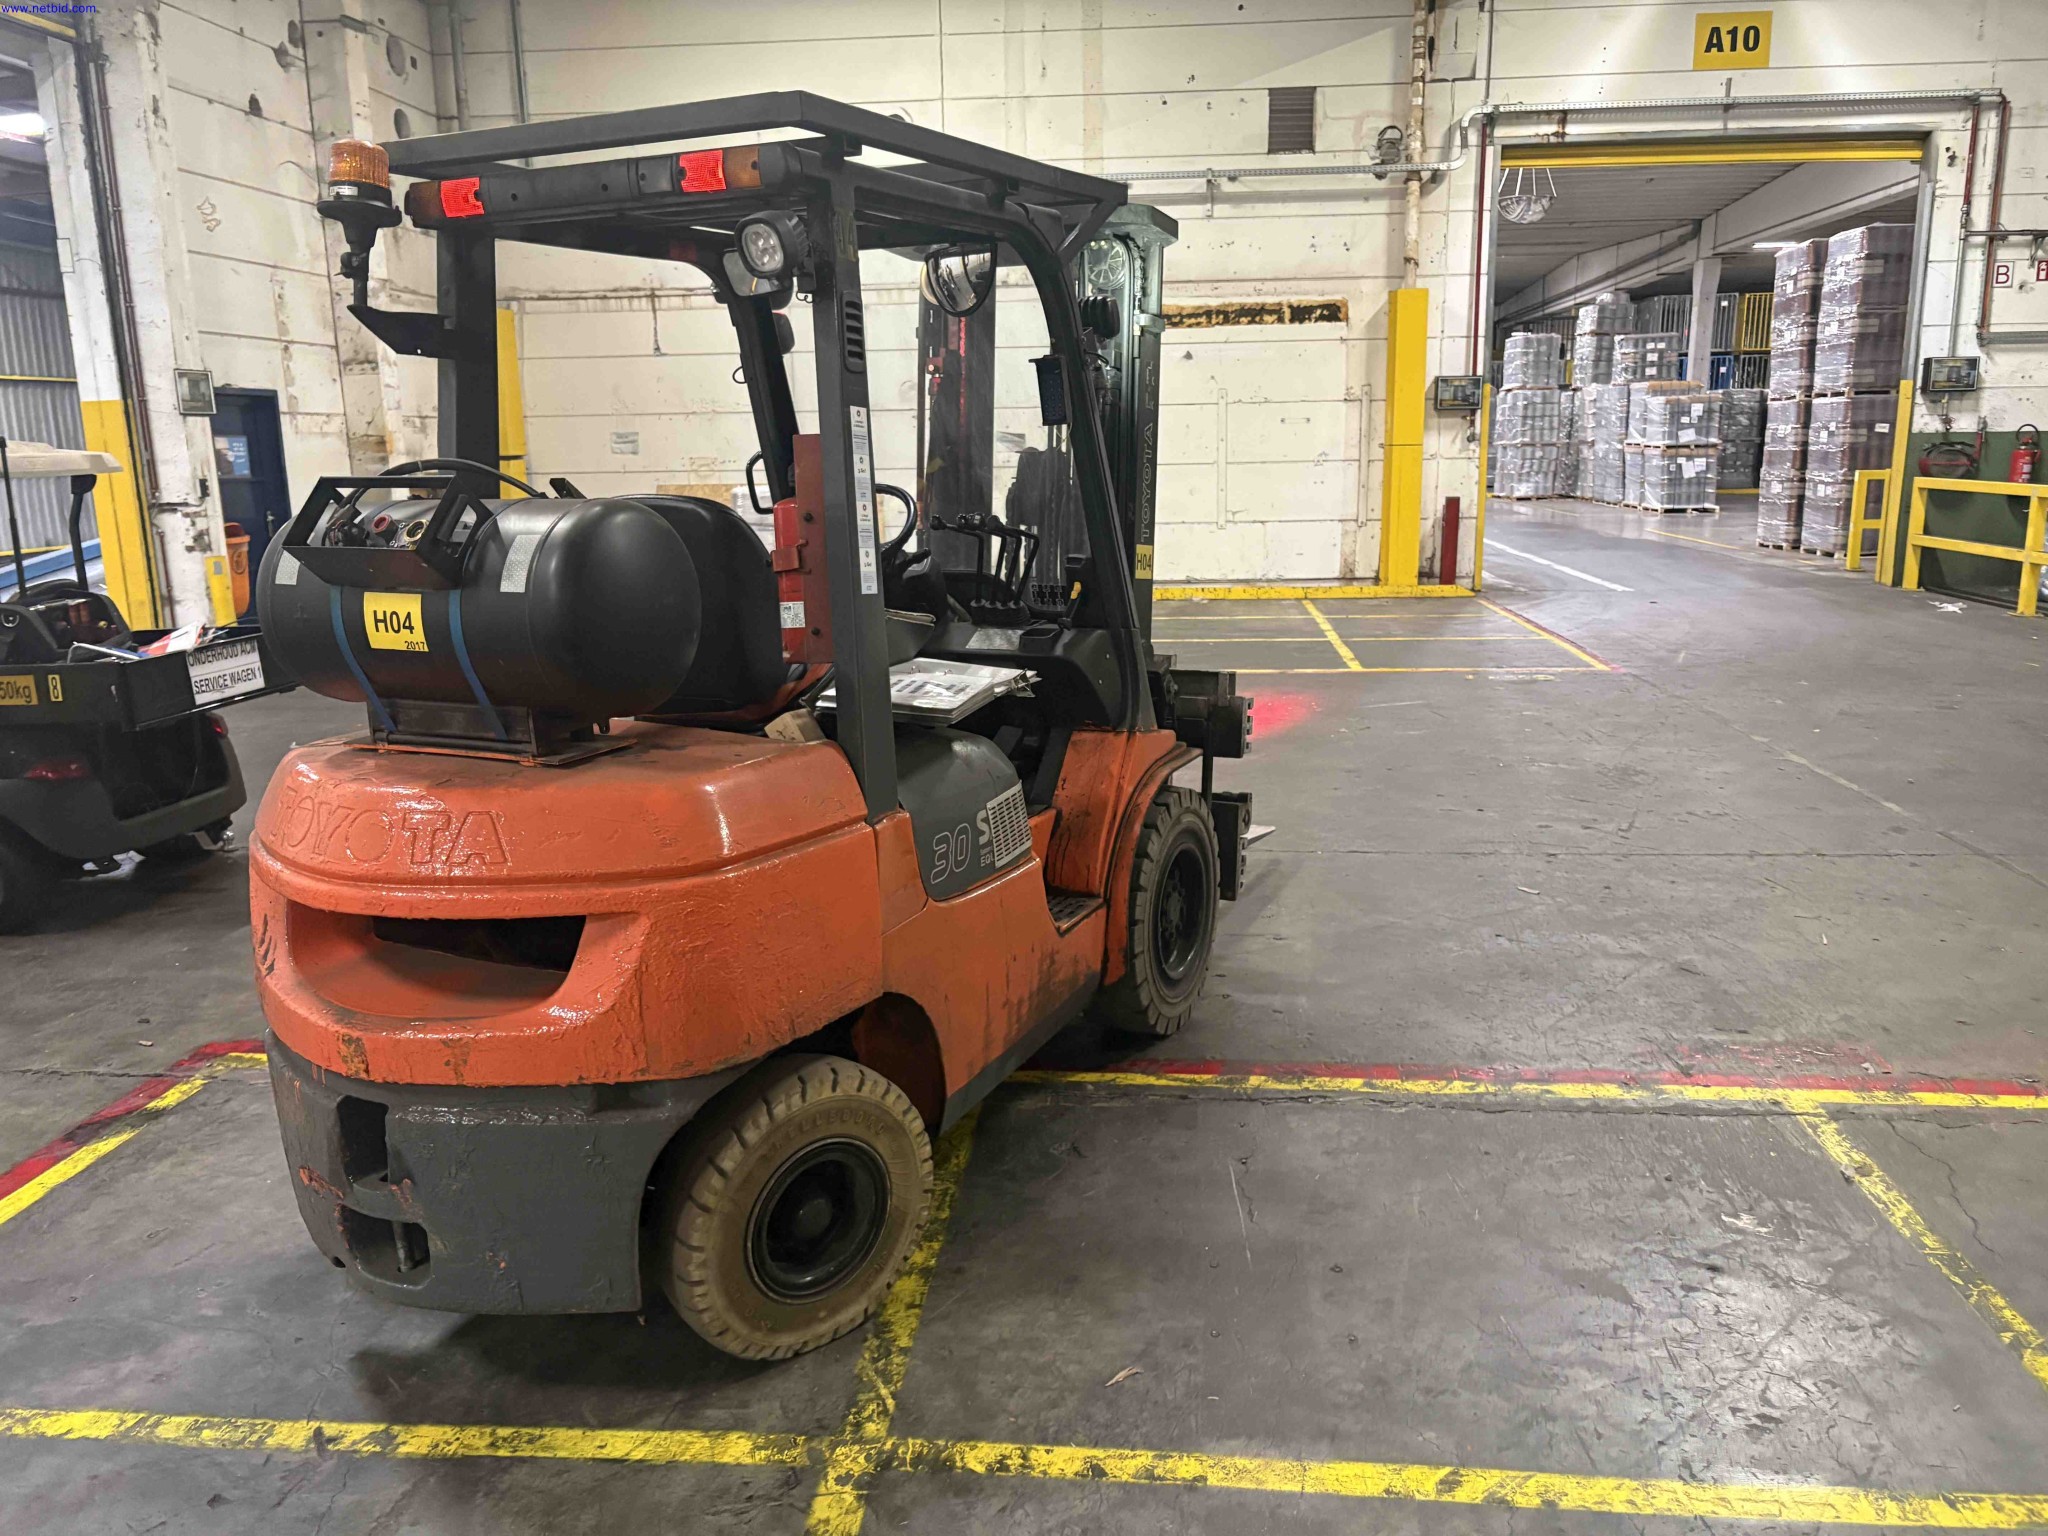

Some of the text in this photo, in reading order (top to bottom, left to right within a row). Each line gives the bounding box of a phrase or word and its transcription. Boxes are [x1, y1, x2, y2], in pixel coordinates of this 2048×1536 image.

[1704, 25, 1761, 53] A10
[1995, 264, 2010, 284] B
[1141, 422, 1153, 542] TOYOTA
[1136, 552, 1152, 571] H04
[373, 610, 415, 634] H04
[187, 645, 239, 666] ONDERHOUD
[404, 641, 425, 650] 2017
[51, 676, 60, 700] 8
[194, 673, 229, 695] SERVICE
[228, 668, 256, 686] WAGEN
[271, 785, 512, 866] TOYOTA
[931, 823, 971, 884] 30
